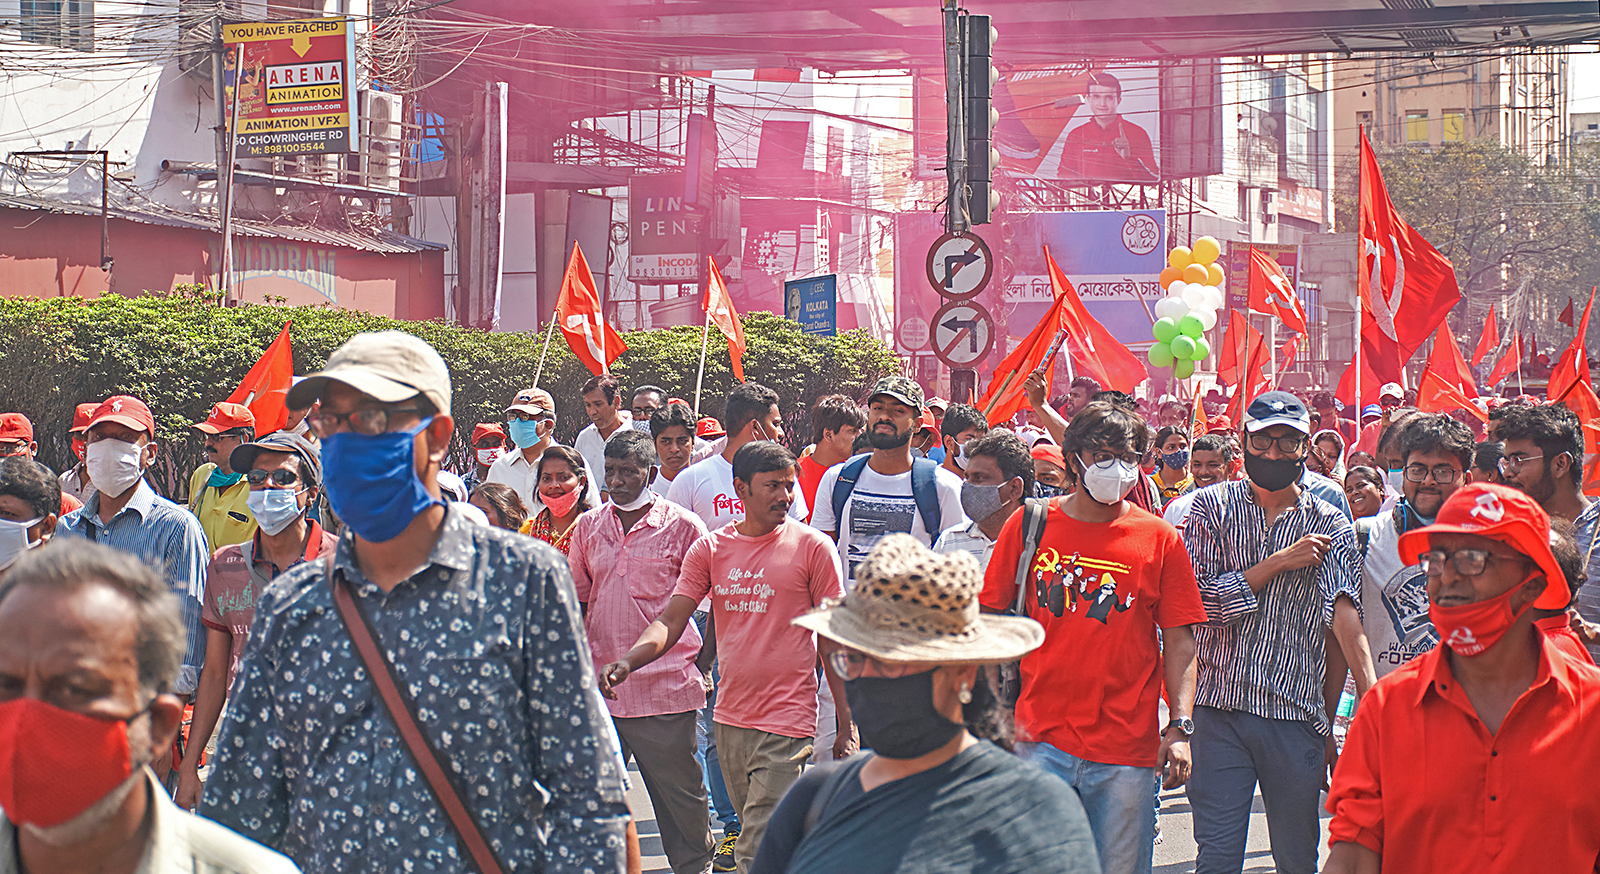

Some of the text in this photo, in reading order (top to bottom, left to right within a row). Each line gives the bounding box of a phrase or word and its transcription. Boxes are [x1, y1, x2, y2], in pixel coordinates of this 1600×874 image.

[230, 22, 339, 38] YOU HAVE REACHED
[269, 65, 340, 85] ARENA
[269, 87, 341, 101] ANIMATION
[270, 103, 341, 114] www.arenach.com
[245, 118, 308, 131] ANIMATION
[318, 116, 341, 126] VFX
[249, 132, 326, 145] CHOWRINGHEE
[329, 130, 344, 140] RD
[251, 142, 325, 155] M: 8981005544
[645, 196, 695, 213] LIN
[805, 300, 829, 312] KOLKATA
[727, 567, 764, 582] Life is A
[730, 583, 752, 596] Time
[753, 583, 776, 599] Offer
